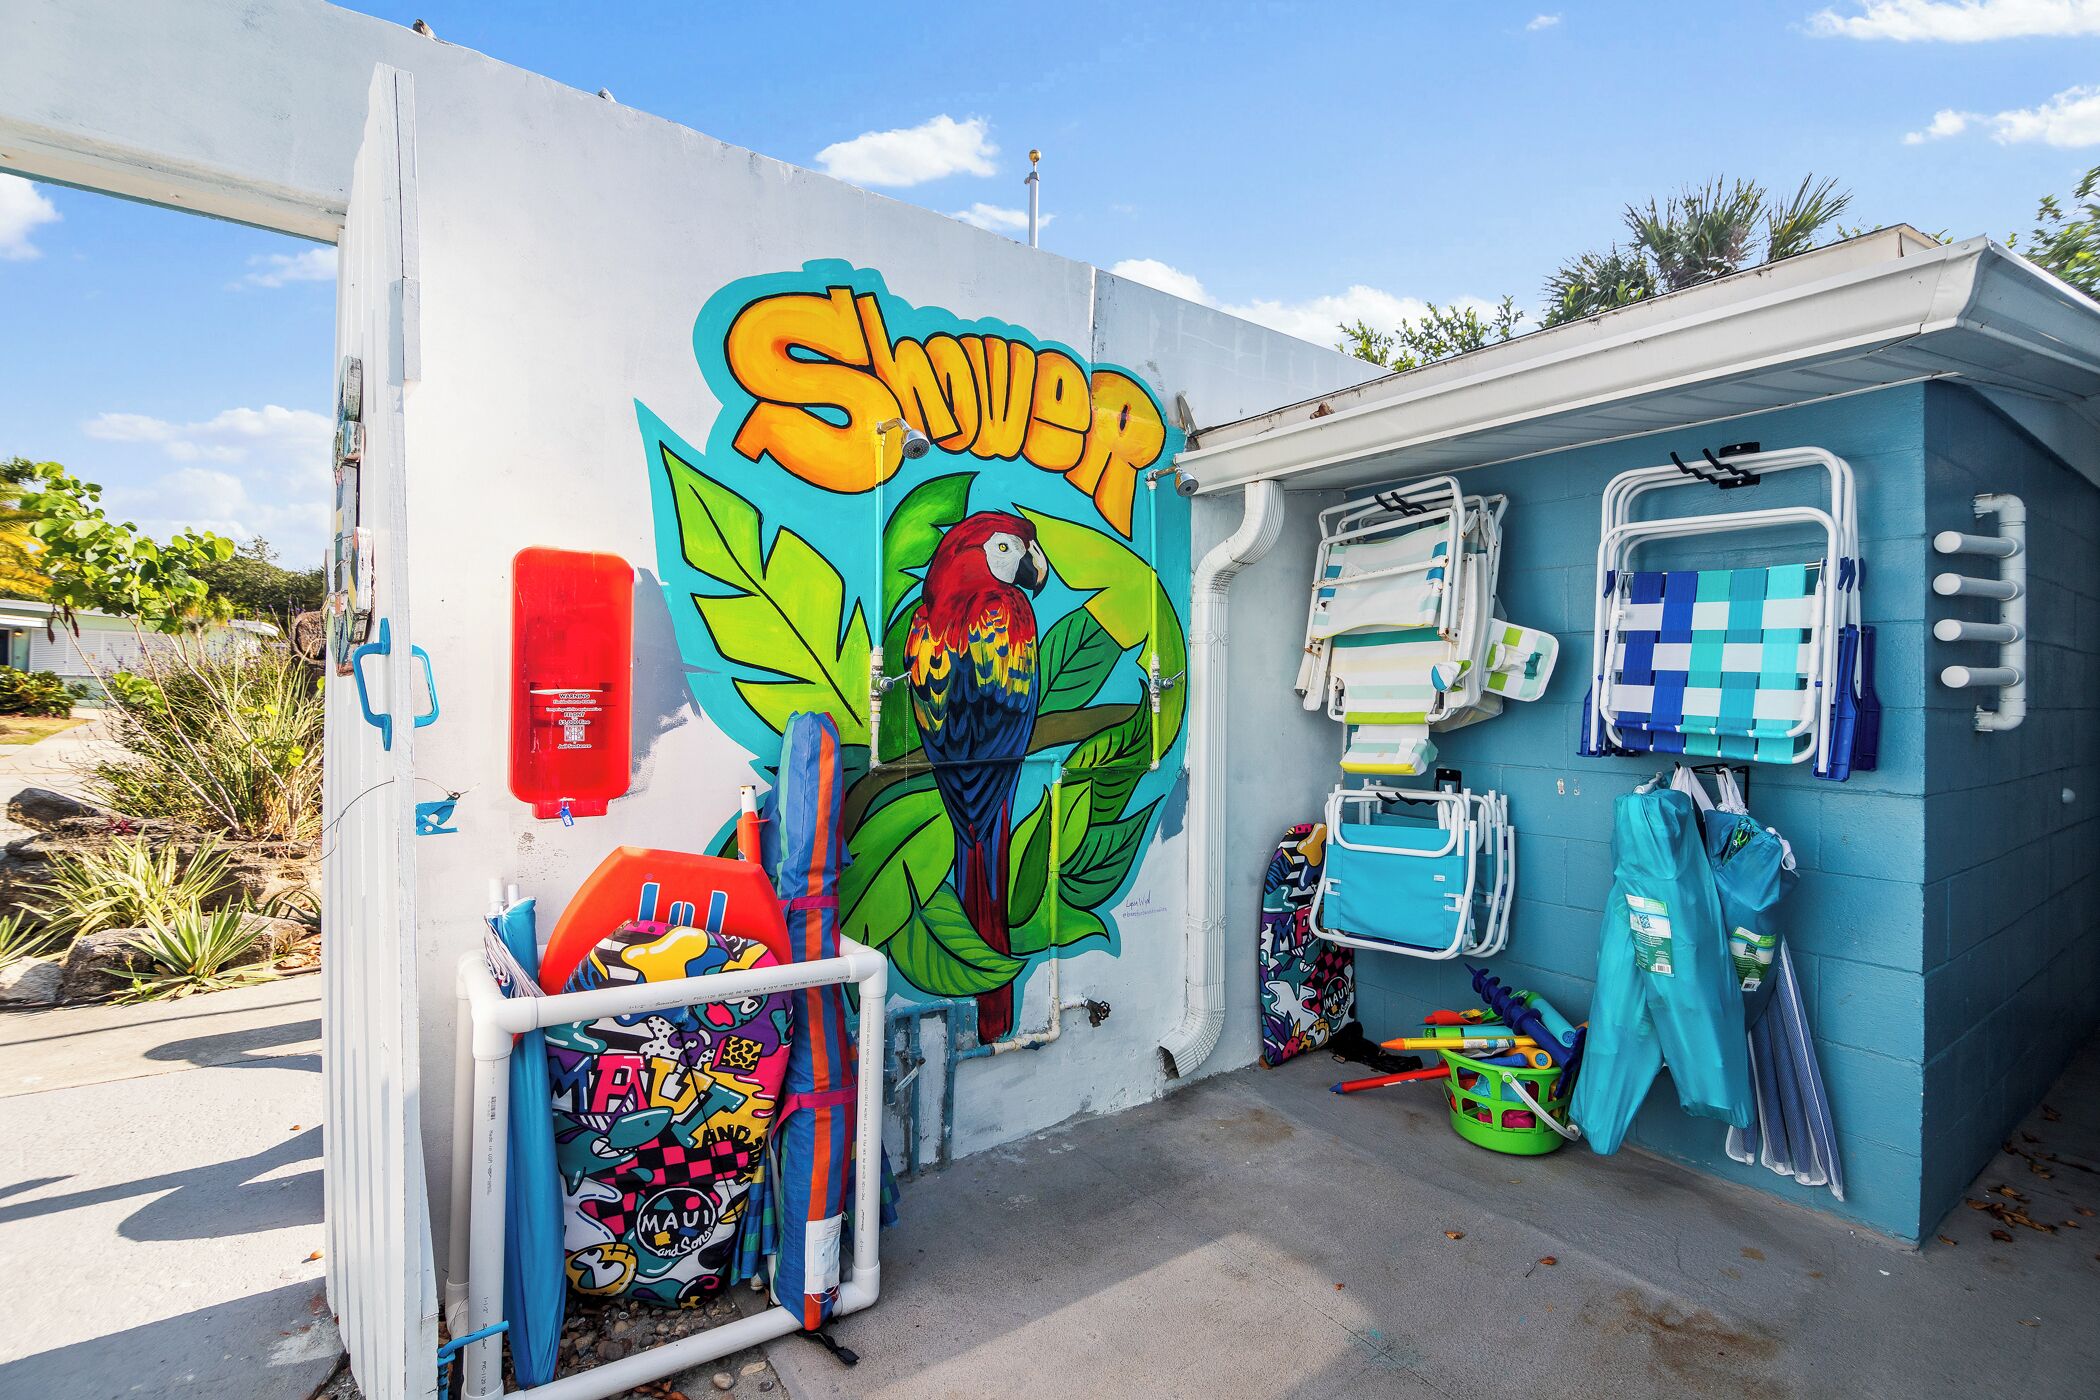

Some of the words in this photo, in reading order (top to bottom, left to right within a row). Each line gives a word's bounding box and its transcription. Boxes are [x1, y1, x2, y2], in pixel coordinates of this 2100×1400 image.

[552, 1053, 749, 1149] MAUI
[702, 1124, 751, 1150] AND
[641, 1210, 709, 1233] MAUI
[658, 1243, 679, 1257] and
